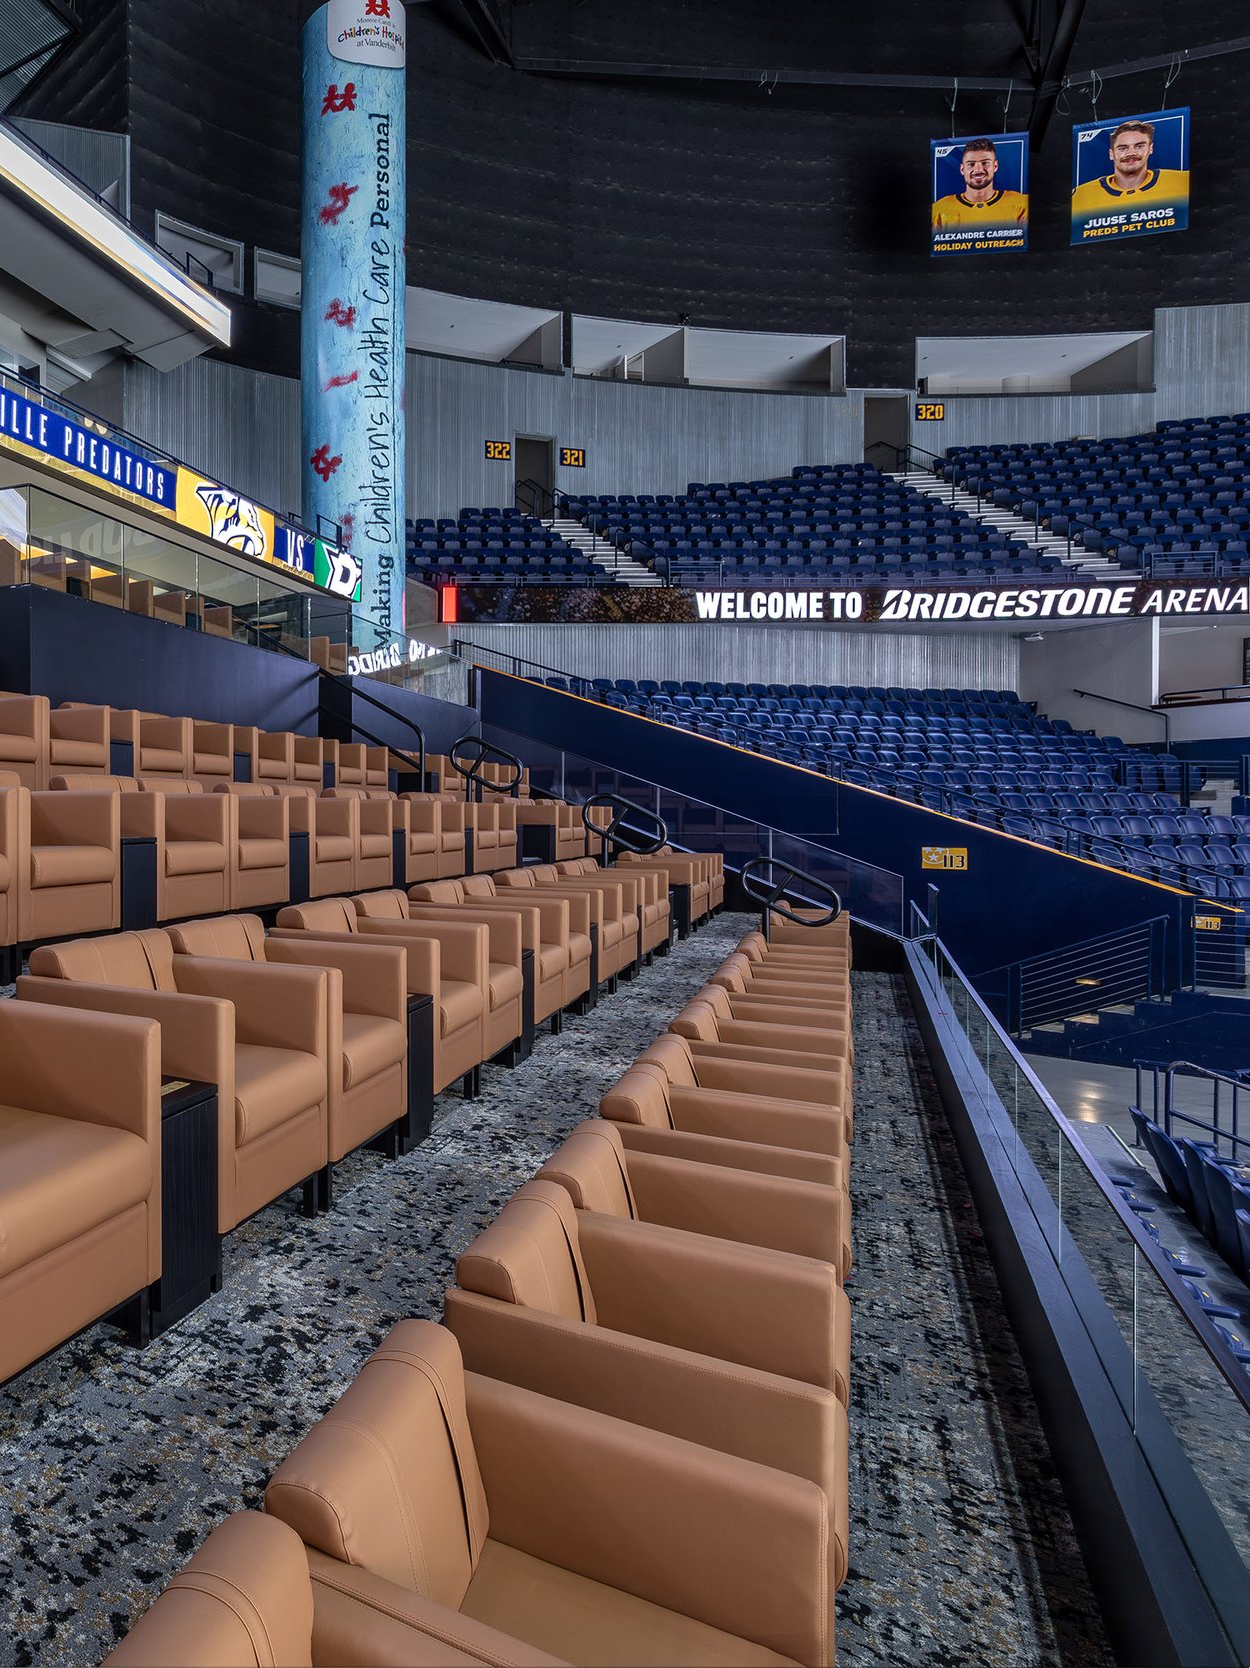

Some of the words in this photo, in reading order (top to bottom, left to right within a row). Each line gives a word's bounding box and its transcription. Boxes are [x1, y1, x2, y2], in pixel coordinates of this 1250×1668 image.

[337, 25, 380, 43] Children's
[368, 113, 390, 230] Personal
[1083, 226, 1119, 238] PREDS
[1122, 223, 1143, 233] PET
[1146, 218, 1176, 229] CLUB
[1084, 215, 1127, 229] JUUSE
[1131, 208, 1174, 221] SAROS
[933, 242, 973, 252] HOLIDAY
[975, 239, 1024, 249] OUTREACH
[934, 231, 985, 242] ALEXANDRE
[987, 229, 1023, 238] CARRIER
[363, 238, 390, 305] Care
[357, 317, 390, 399] Health
[917, 404, 944, 420] 320
[486, 442, 510, 459] 322
[563, 449, 583, 466] 321
[64, 425, 165, 500] PREDATORS
[360, 411, 392, 544] Children's
[286, 528, 305, 572] VS
[696, 591, 824, 619] WELCOME
[830, 591, 863, 619] TO
[878, 586, 1137, 620] BRIDGESTONE
[1141, 586, 1249, 614] ARENA
[943, 854, 965, 868] 113
